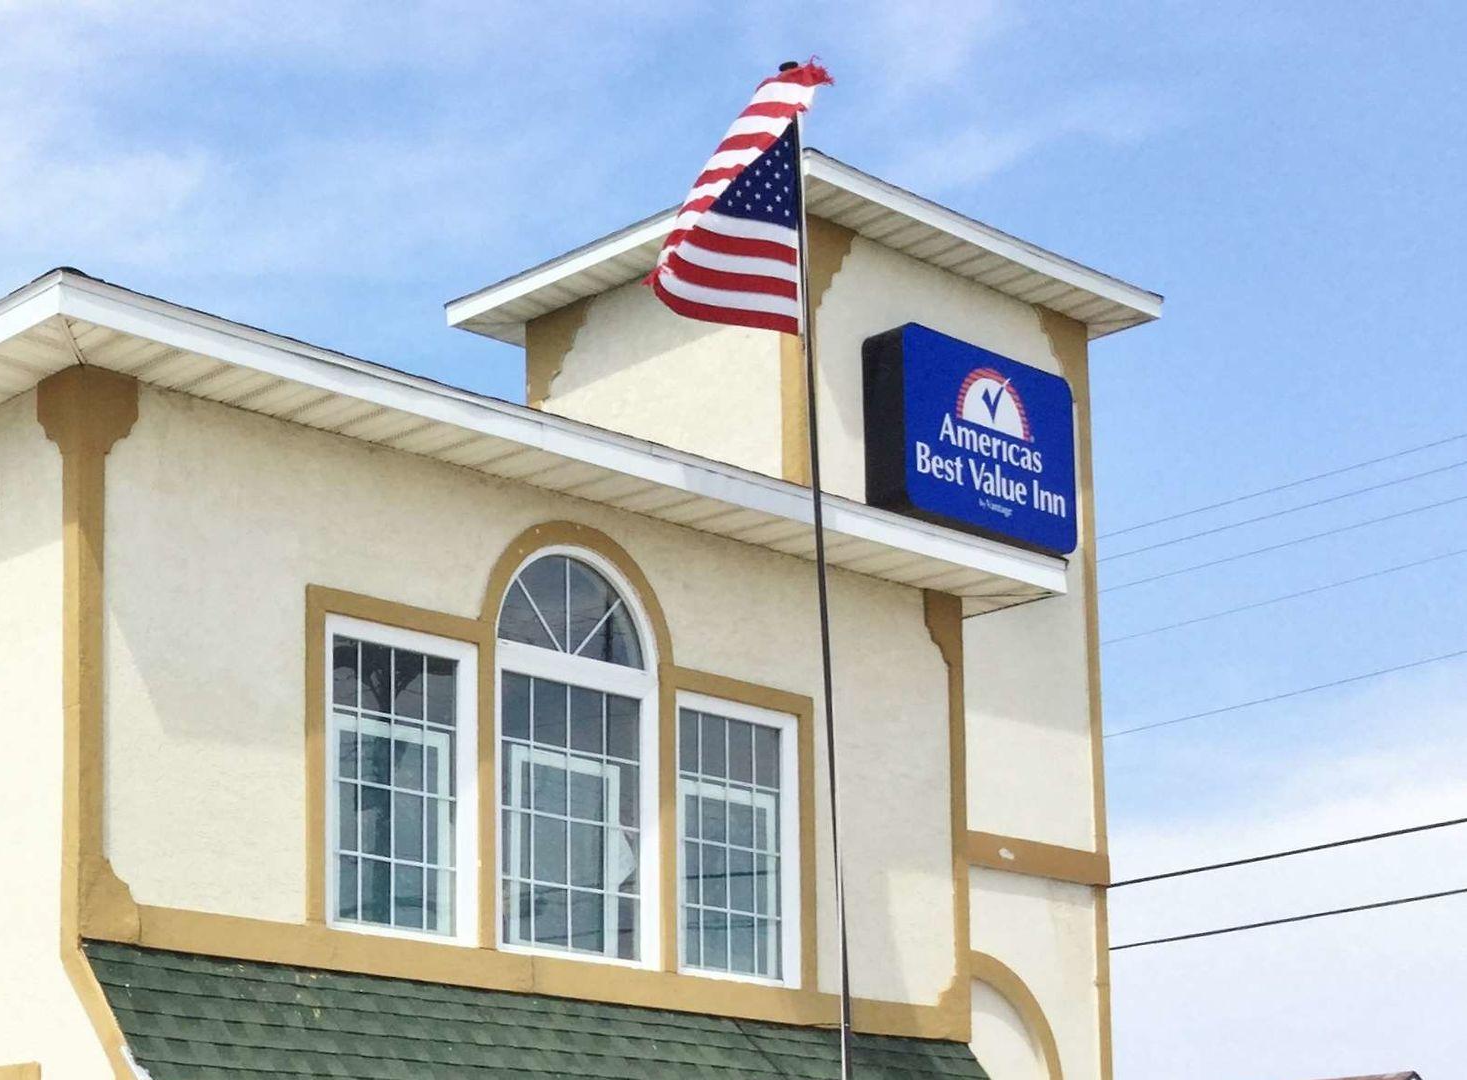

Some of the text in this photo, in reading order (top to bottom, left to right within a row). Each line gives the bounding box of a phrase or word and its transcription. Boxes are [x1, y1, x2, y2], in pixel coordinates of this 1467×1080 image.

[939, 413, 1043, 473] Americas
[916, 441, 964, 486] Best
[968, 458, 1027, 505] Value
[1033, 479, 1066, 518] Inn
